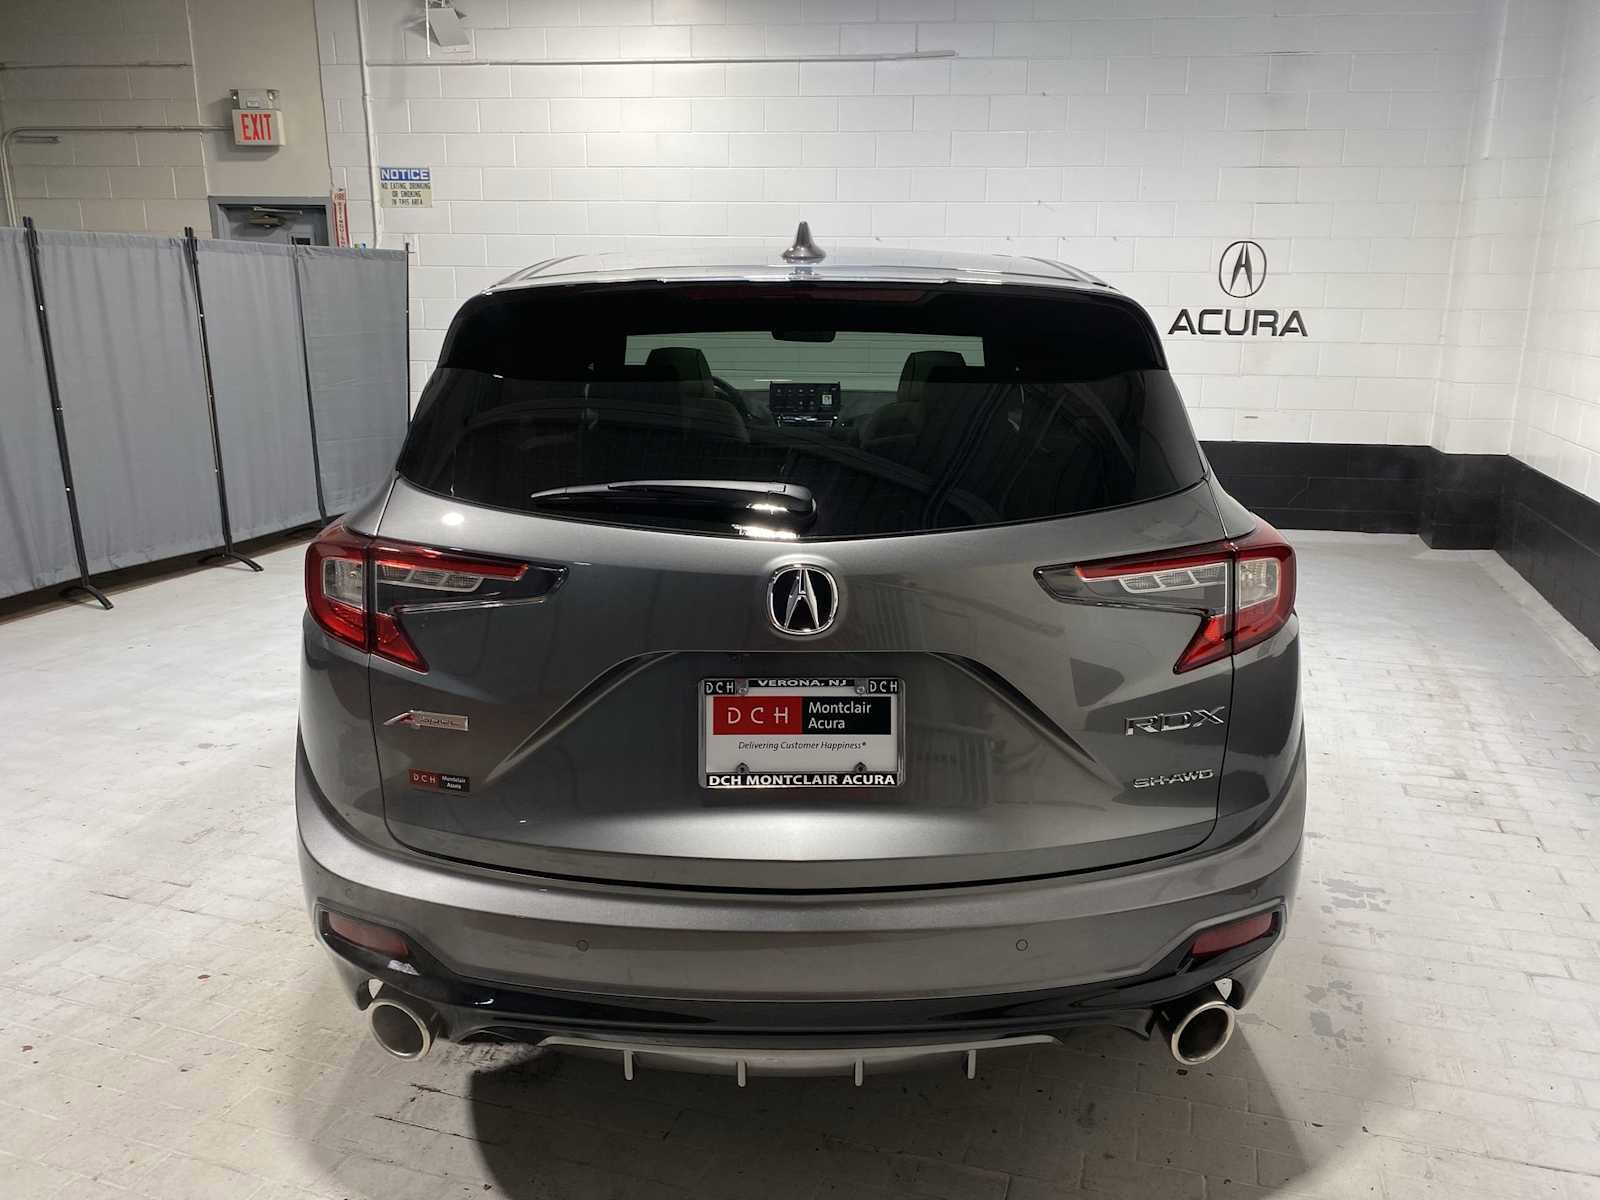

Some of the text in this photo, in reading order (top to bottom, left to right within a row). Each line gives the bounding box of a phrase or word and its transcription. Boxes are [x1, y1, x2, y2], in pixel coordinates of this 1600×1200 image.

[240, 113, 271, 140] EXIT
[381, 169, 430, 180] NOTICE
[401, 190, 421, 198] SMOKING
[1167, 308, 1309, 337] ACURA
[829, 679, 847, 687] NJ
[808, 701, 871, 714] Montclair
[808, 718, 846, 729] Acura
[1124, 706, 1225, 736] RDX
[738, 741, 779, 751] Delivering
[780, 741, 819, 750] Customer
[709, 774, 895, 785] DCH MONTCLAIR ACURA
[1133, 769, 1214, 788] SH-AWD
